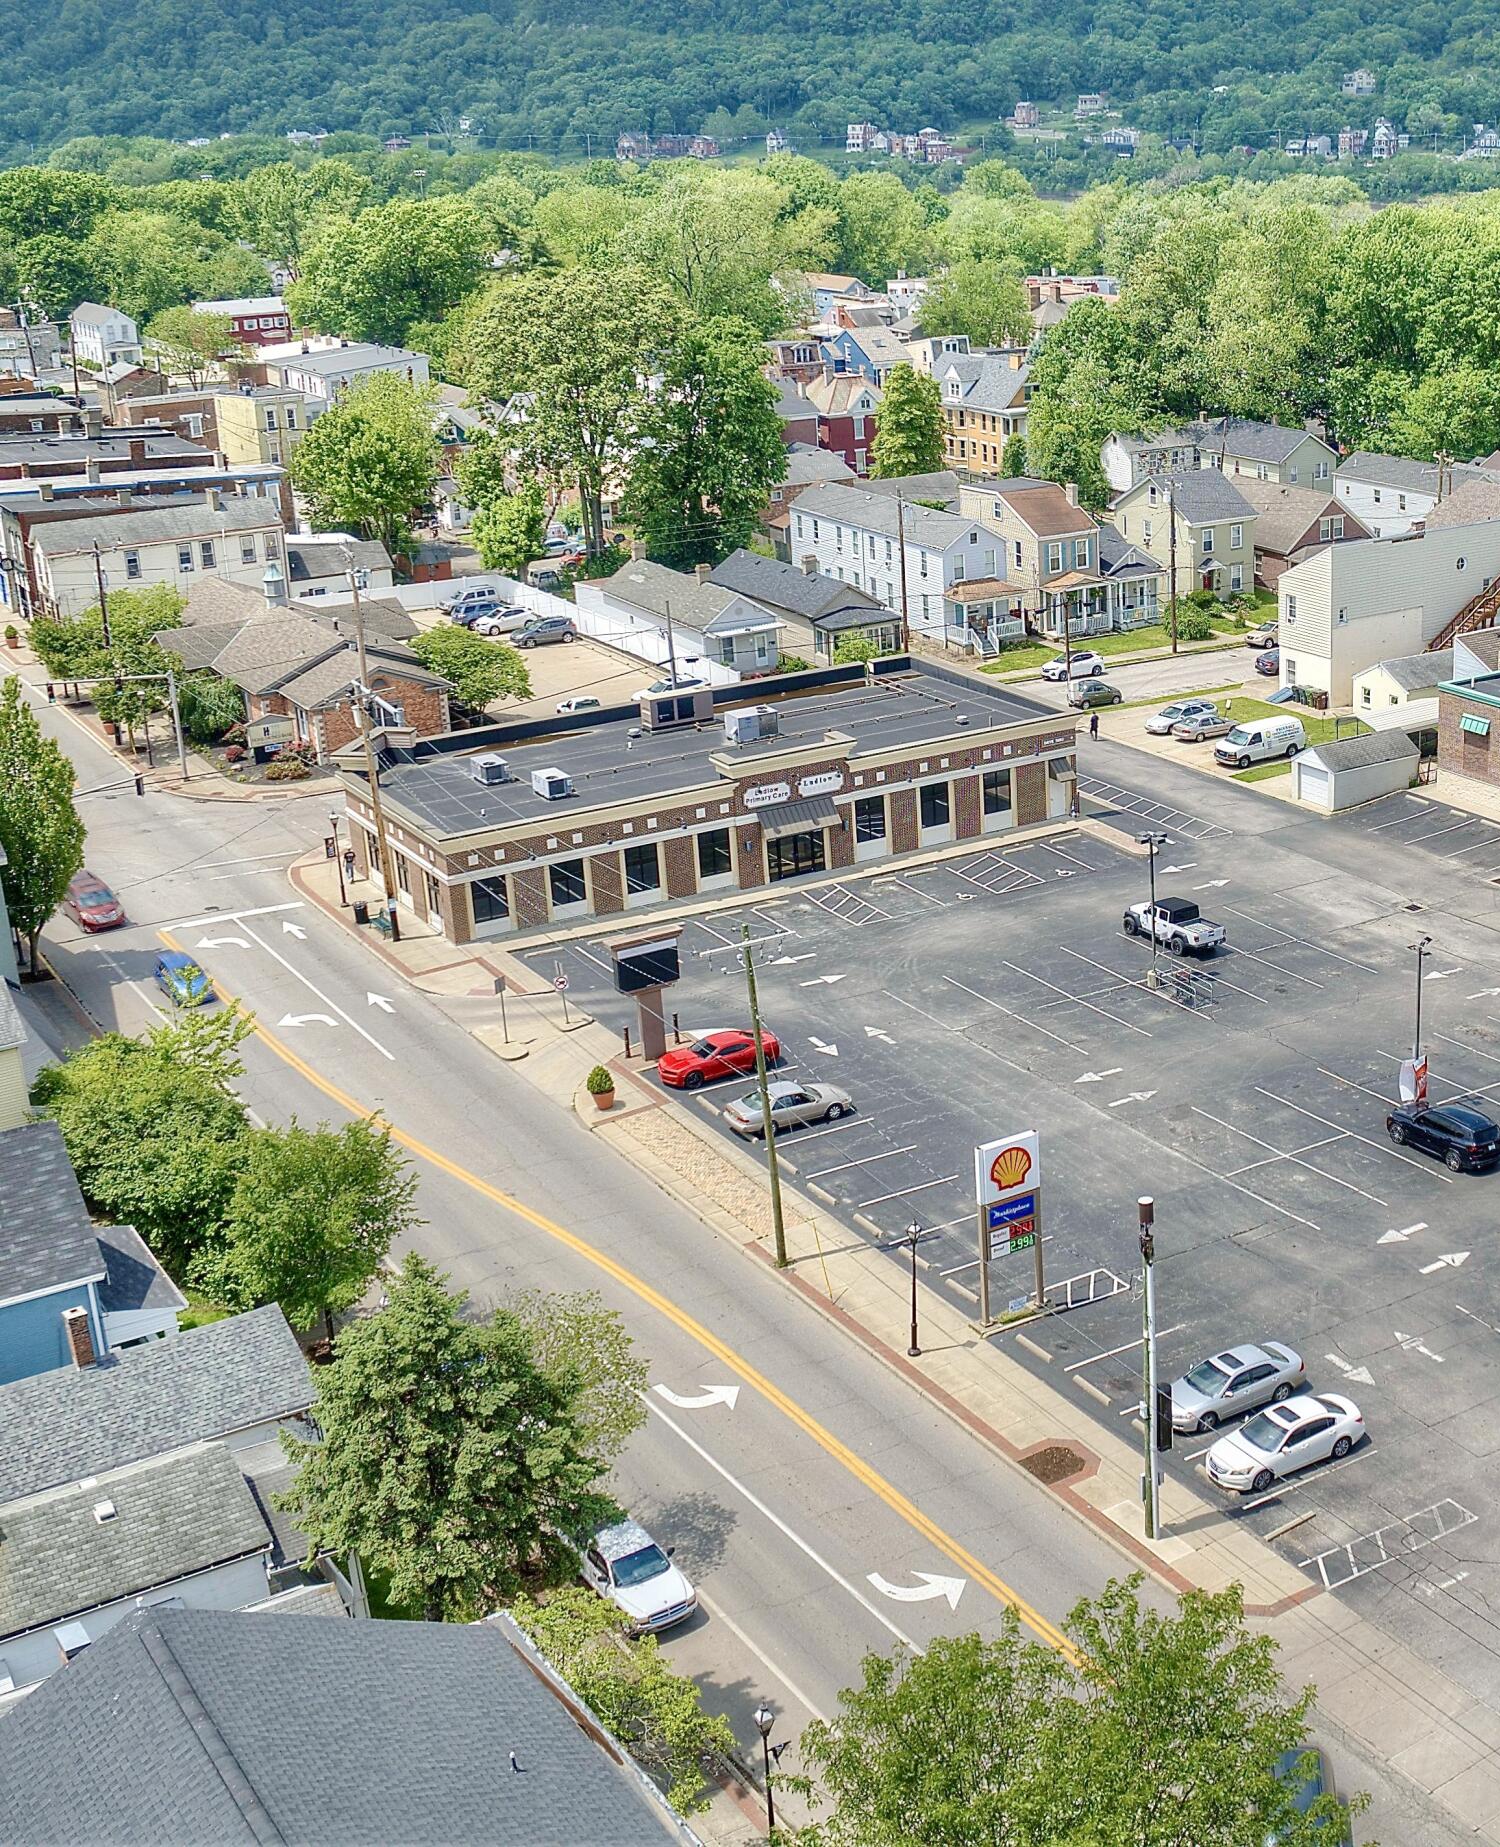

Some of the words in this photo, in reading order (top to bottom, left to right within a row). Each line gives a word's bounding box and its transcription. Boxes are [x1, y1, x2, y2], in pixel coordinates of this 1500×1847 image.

[803, 776, 833, 787] Ludlow
[745, 795, 772, 804] Primary
[772, 791, 789, 799] Care
